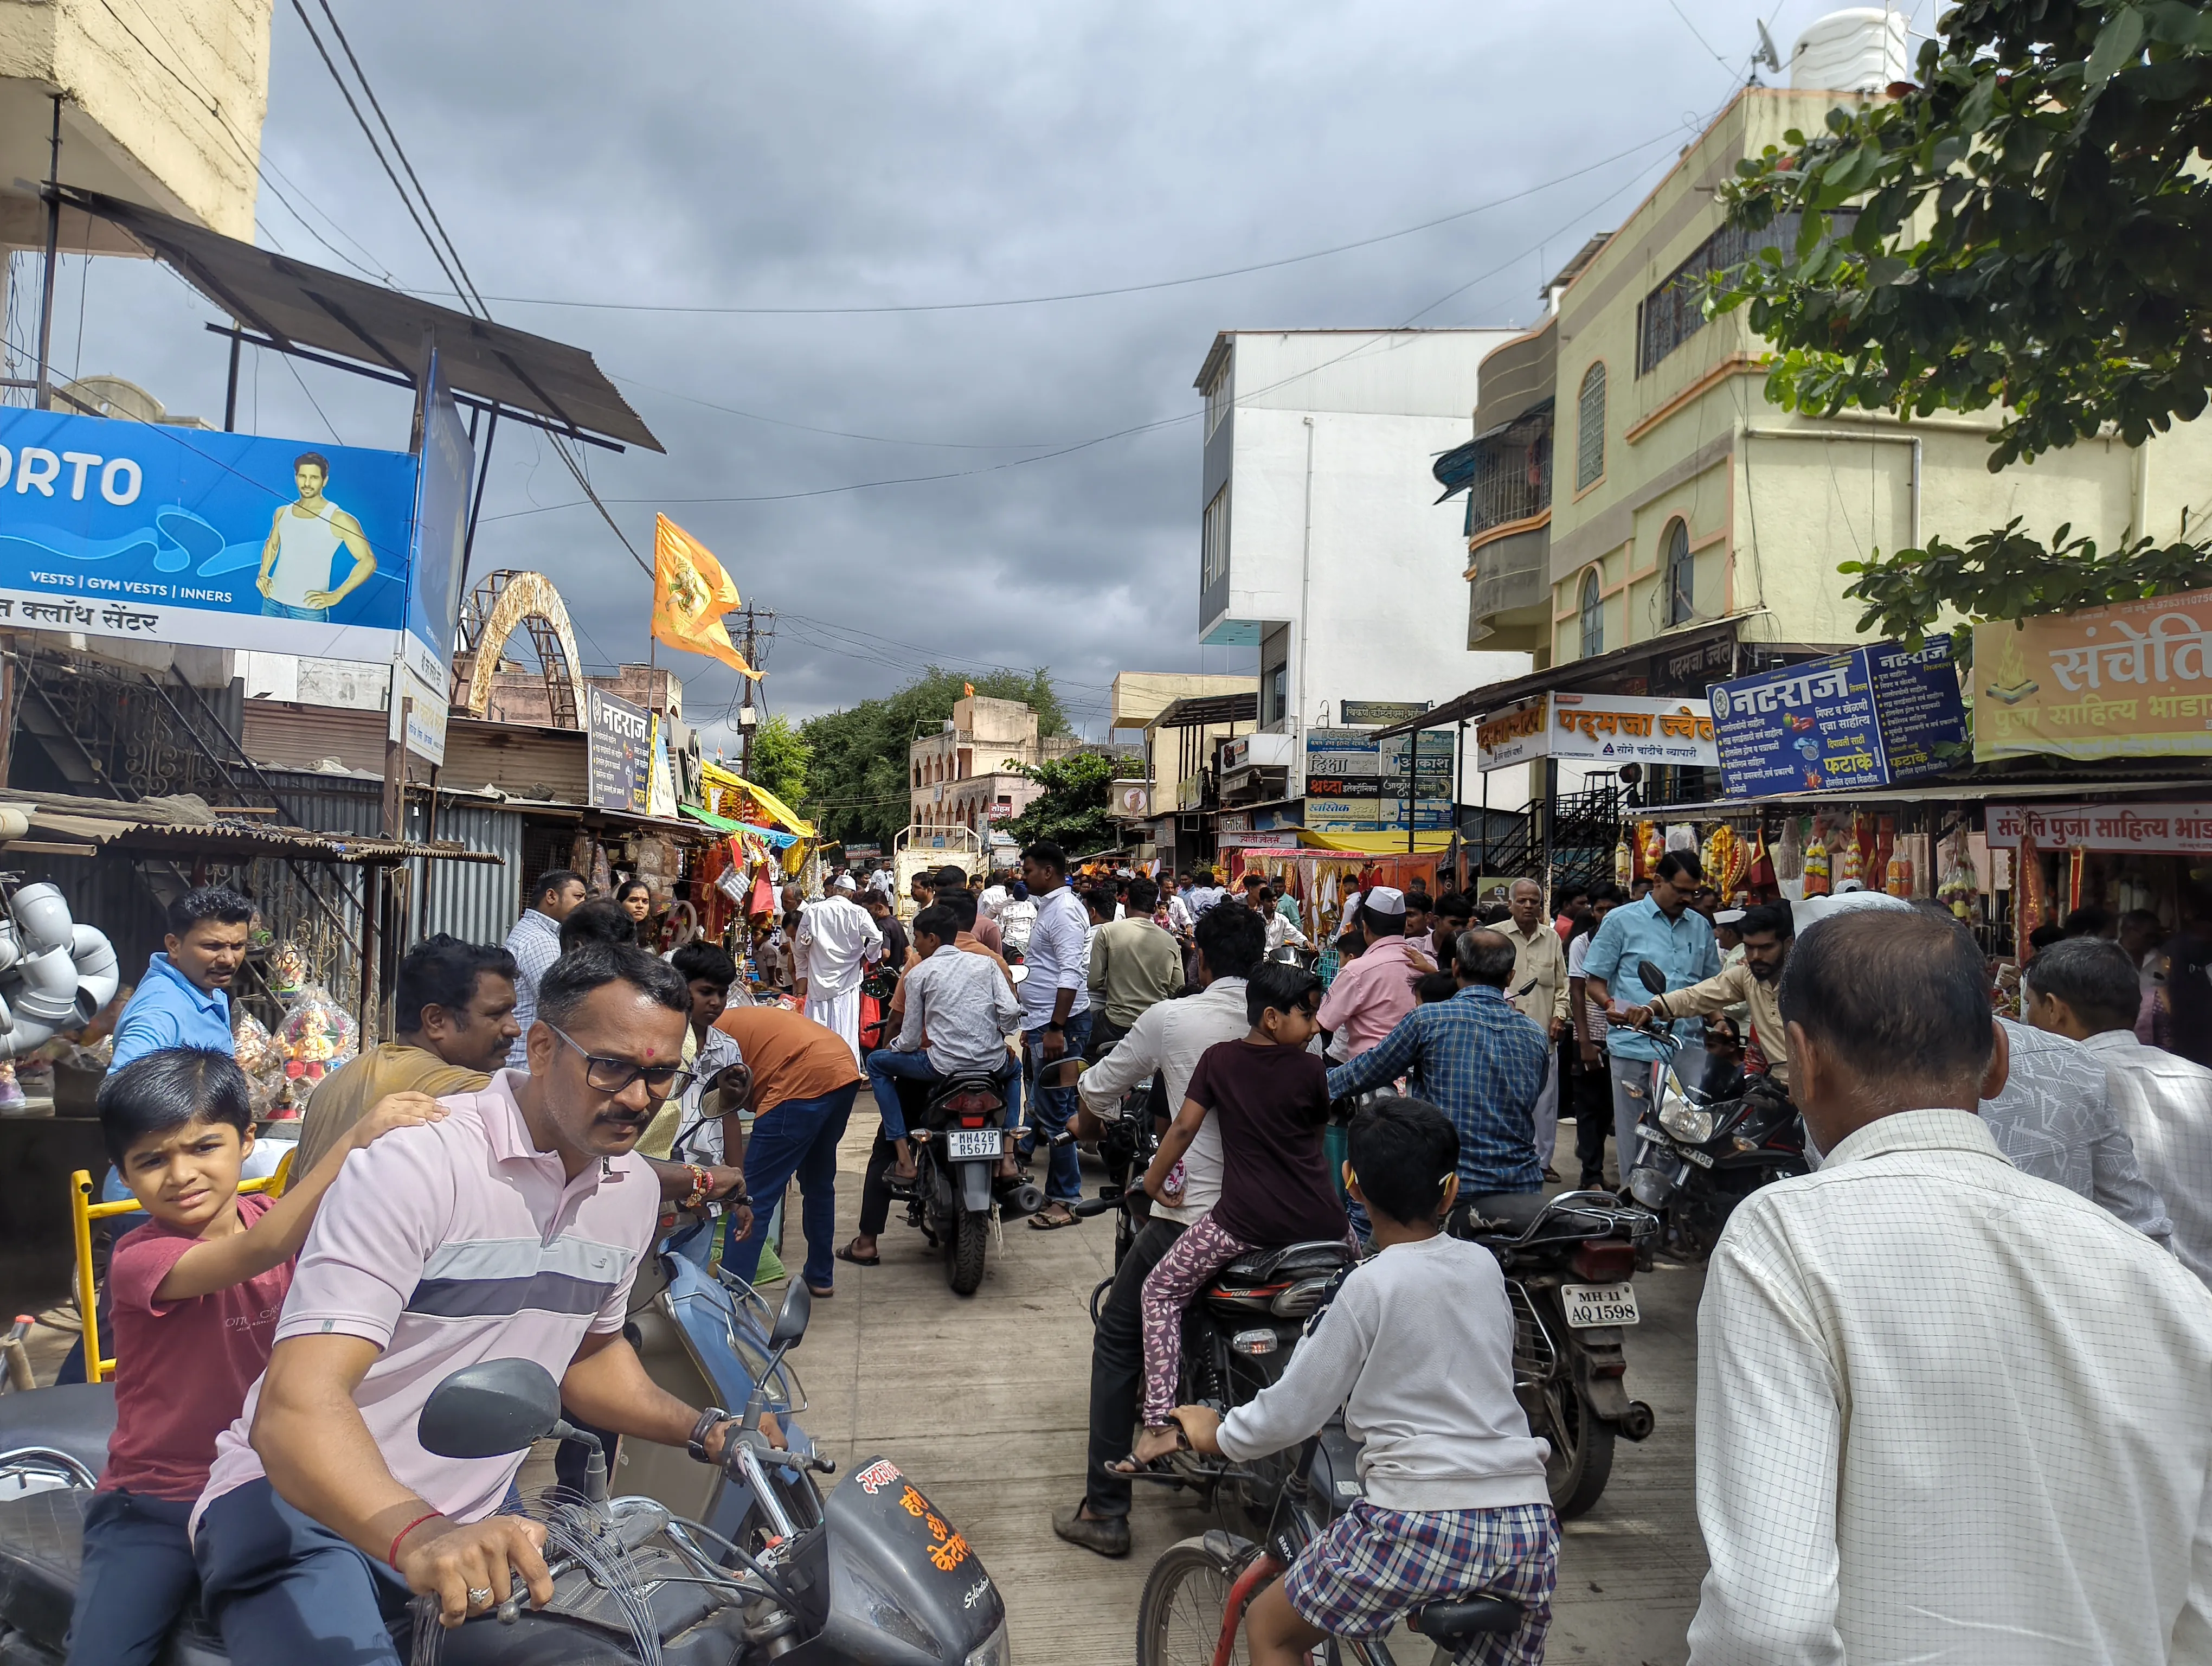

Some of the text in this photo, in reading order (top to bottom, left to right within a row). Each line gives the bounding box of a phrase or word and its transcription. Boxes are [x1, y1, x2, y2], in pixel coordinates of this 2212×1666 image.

[30, 571, 232, 603] VESTS GYM VESTS INNERS
[22, 599, 95, 626] क्लॉथ
[102, 603, 159, 633] सेंटर
[1879, 645, 1947, 668] नटराज
[1730, 666, 1849, 715] नटराज
[1346, 706, 1369, 717] चिकणे
[1815, 697, 1868, 719] गिफ्ट व खेळणी
[1992, 707, 2040, 737] पुजा
[2048, 693, 2139, 727] साहित्य
[602, 702, 647, 743] नटराज
[1558, 708, 1655, 742] पद्मजा
[1819, 714, 1870, 735] पुजा साहीत्य
[1616, 744, 1697, 758] सोने चांदीचे व्यापारी
[1823, 747, 1873, 775] फटाके
[1889, 749, 1928, 767] फटाके
[1342, 783, 1378, 794] इलेक्ट्रॉनिक्स
[1309, 802, 1351, 812] स्वस्तिक
[2050, 818, 2091, 845] पुजा
[2095, 810, 2170, 842] साहित्य
[1238, 834, 1281, 844] ज्योती ज्वेलर्स
[1688, 1085, 1712, 1099] HONDA
[960, 1143, 994, 1155] R5677
[1572, 1304, 1635, 1323] AQ 1598
[1278, 1535, 1293, 1561] BMX
